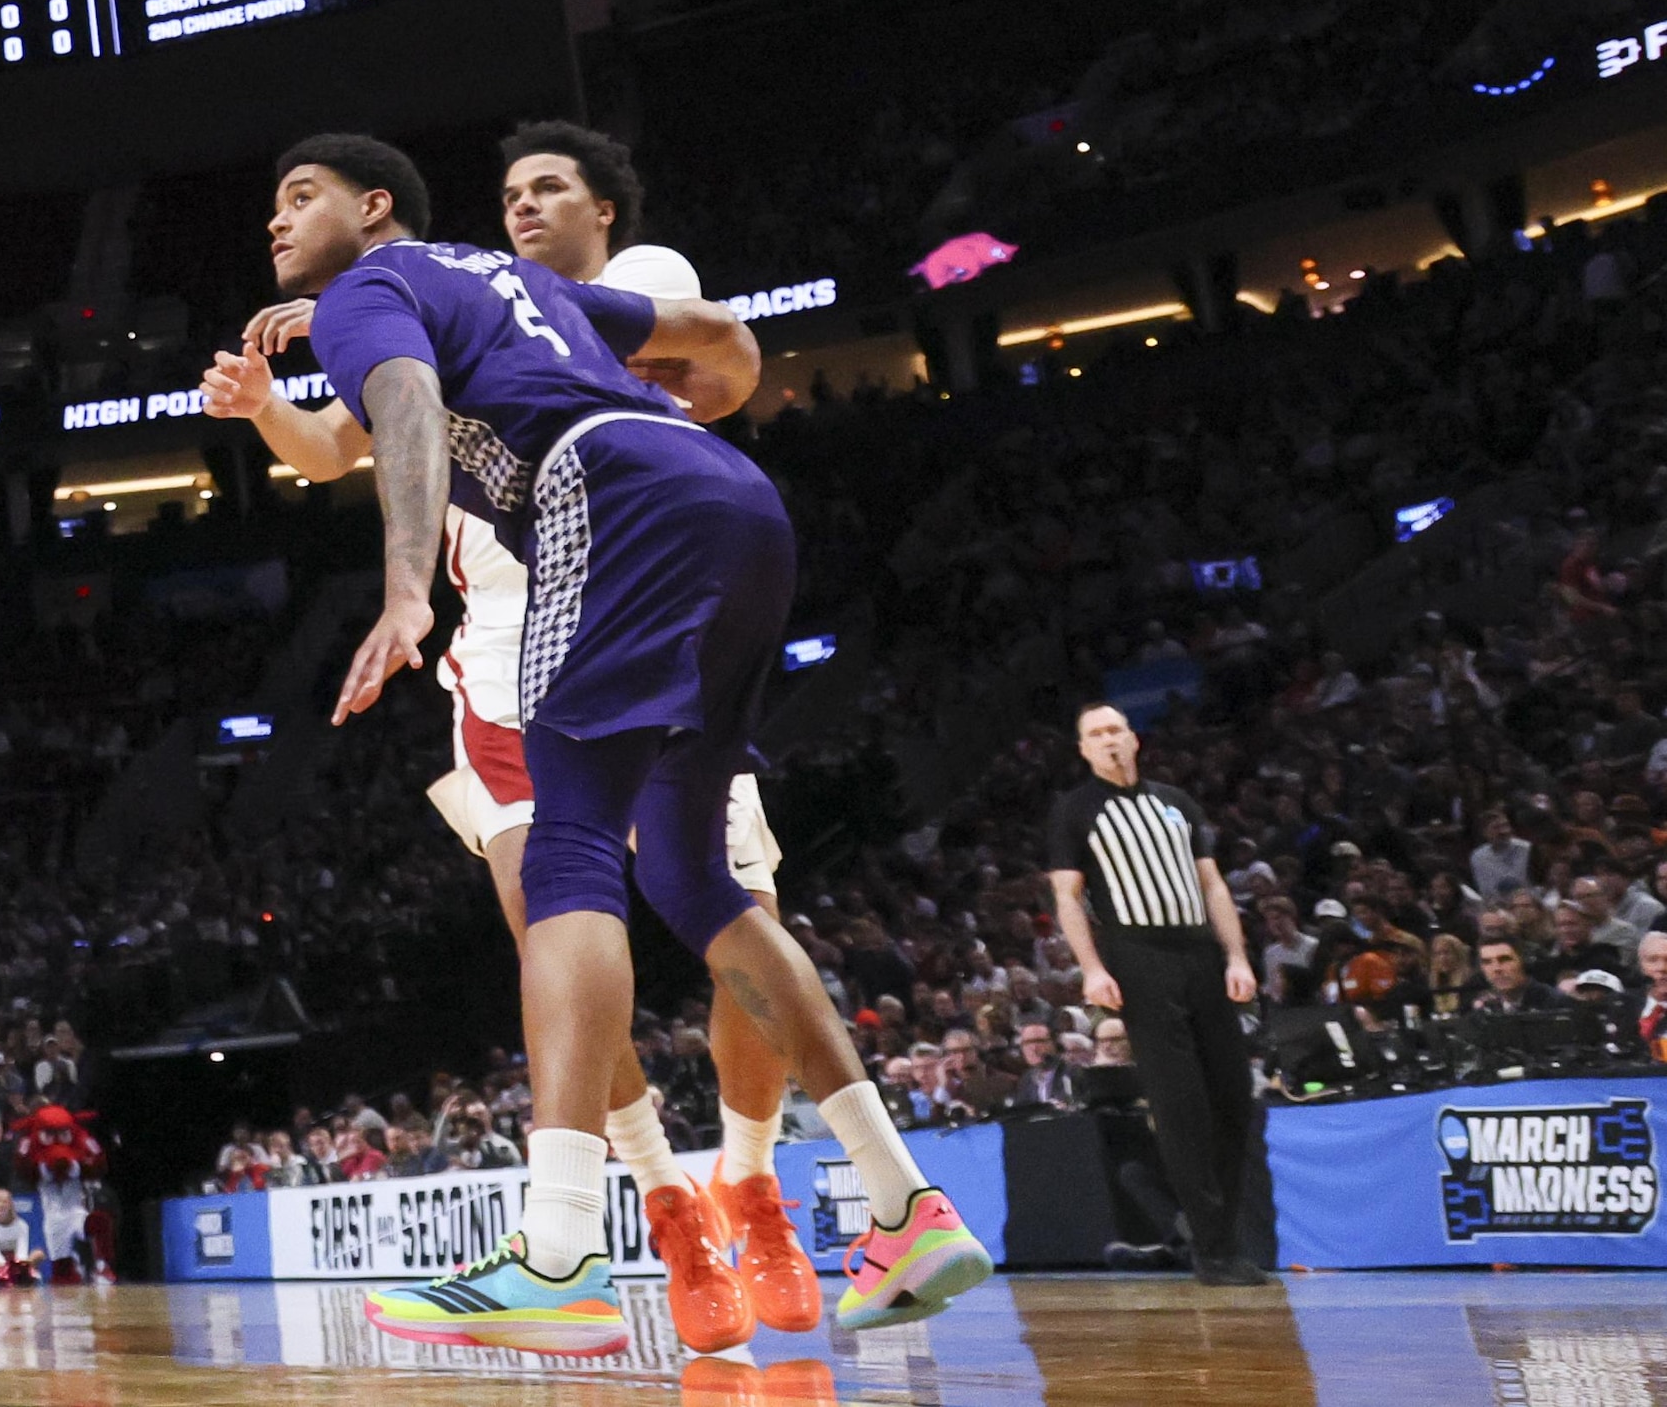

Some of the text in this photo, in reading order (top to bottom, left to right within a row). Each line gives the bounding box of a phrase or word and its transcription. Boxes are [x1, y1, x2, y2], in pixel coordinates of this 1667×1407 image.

[182, 5, 245, 34] CHANCE
[489, 269, 571, 357] 2
[727, 278, 836, 322] BACKS
[64, 390, 205, 430] HIGH POI
[1468, 1115, 1591, 1164] MARCH
[1492, 1165, 1654, 1214] MADNESS
[311, 1194, 374, 1270] FIRST
[400, 1184, 506, 1269] SECOND
